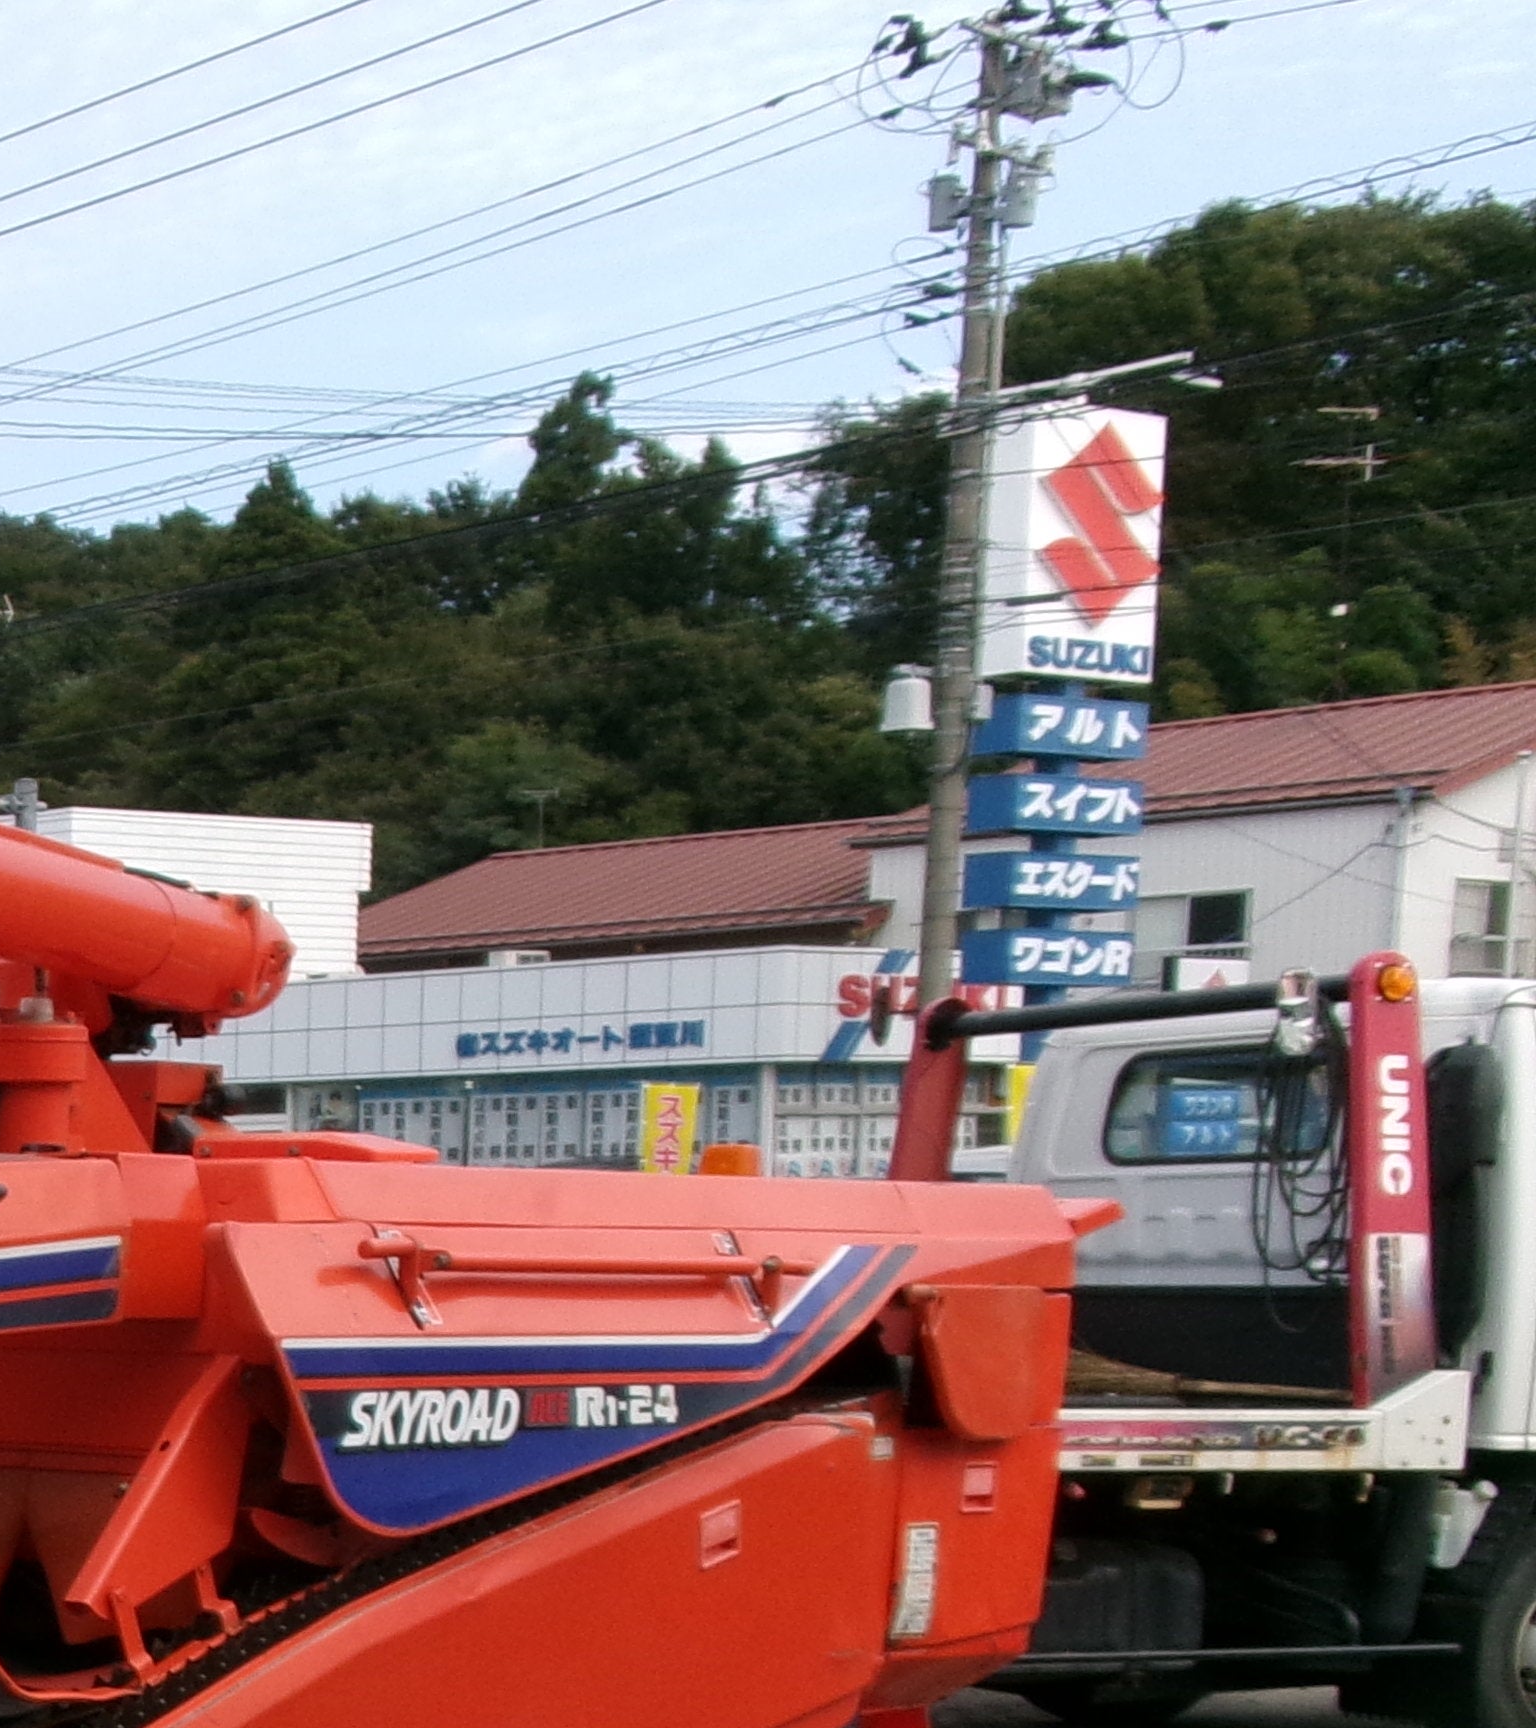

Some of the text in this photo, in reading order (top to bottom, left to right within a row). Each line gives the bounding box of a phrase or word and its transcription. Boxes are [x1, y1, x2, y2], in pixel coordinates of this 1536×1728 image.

[1028, 634, 1150, 675] SUZUKI
[1028, 703, 1142, 750] アルト
[1020, 782, 1142, 824] スイフト
[1014, 860, 1141, 901] エスクード
[1011, 936, 1133, 977] ワゴンR
[1380, 1054, 1413, 1196] UNIC
[340, 1387, 521, 1448] SKYROAD
